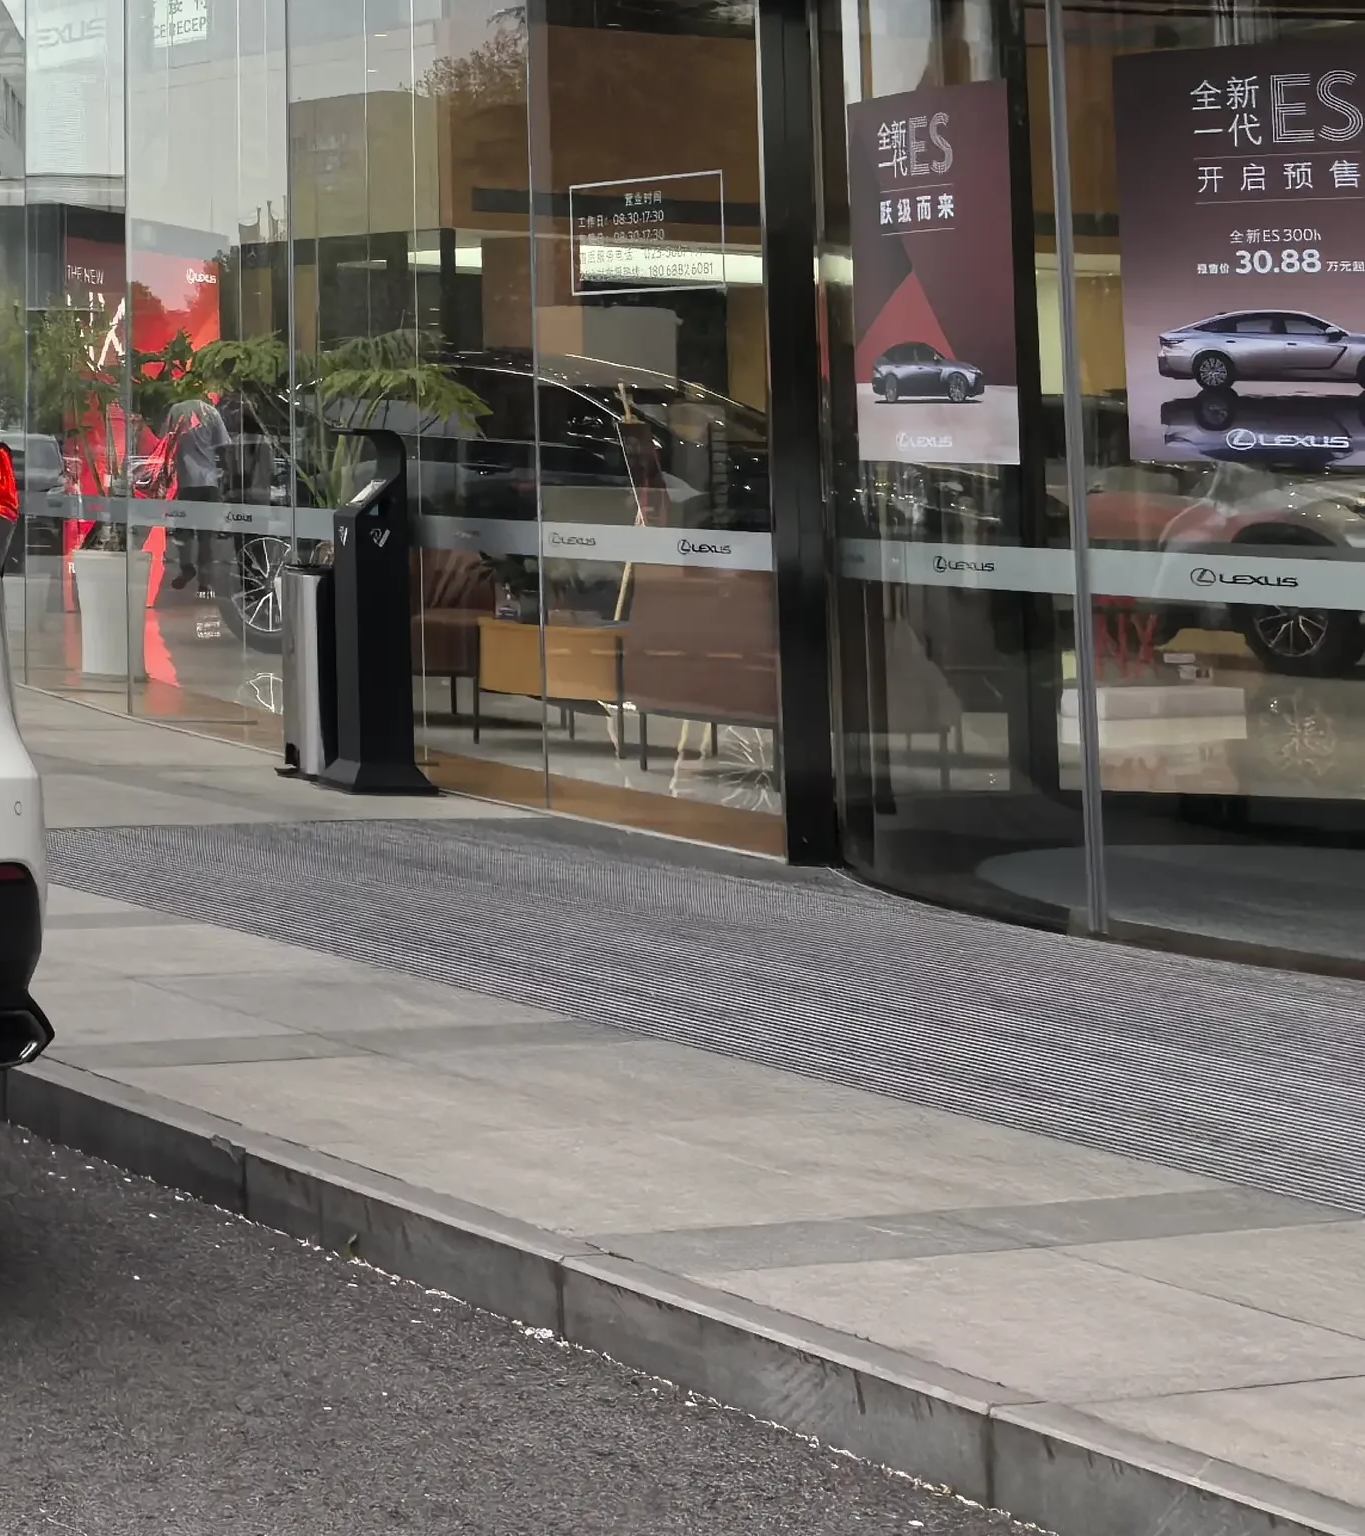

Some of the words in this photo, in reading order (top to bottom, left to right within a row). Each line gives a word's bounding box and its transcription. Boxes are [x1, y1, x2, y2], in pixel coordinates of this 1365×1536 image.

[1190, 76, 1259, 111] 全新
[1269, 69, 1364, 143] ES
[877, 120, 906, 151] 全新
[909, 111, 953, 176] ES
[1193, 112, 1262, 147] 一代
[878, 148, 908, 178] 一代
[1197, 160, 1361, 193] 开启预售
[880, 193, 954, 225] 跃级而来
[1235, 249, 1321, 274] 30.88
[911, 436, 953, 448] LEXUS
[1258, 435, 1351, 449] LEXUS
[691, 543, 732, 555] LEXUS
[947, 561, 995, 572] LEXUS
[1219, 573, 1299, 588] LEXUS
